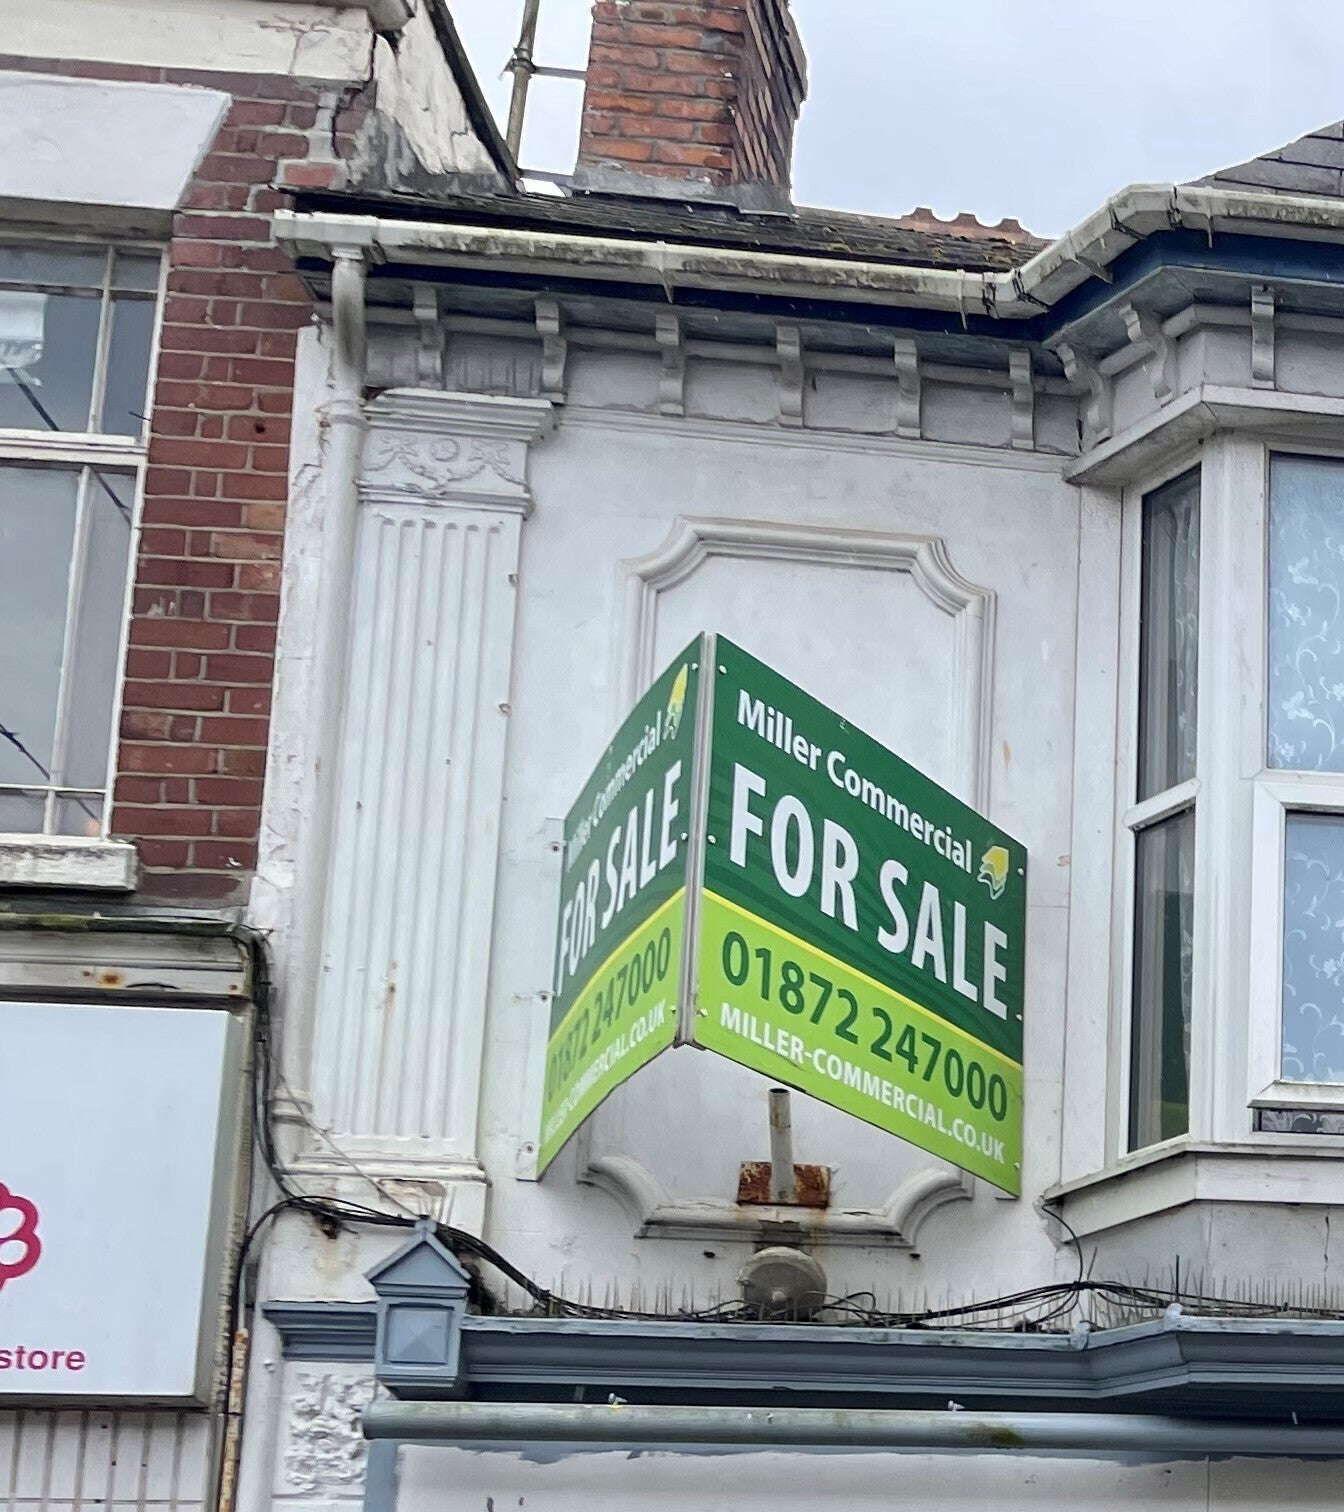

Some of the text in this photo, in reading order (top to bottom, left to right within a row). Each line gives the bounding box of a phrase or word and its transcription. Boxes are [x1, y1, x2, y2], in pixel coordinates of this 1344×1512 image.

[737, 689, 973, 874] Miller Commercial
[555, 857, 601, 997] FOR
[601, 759, 682, 931] SALE
[729, 762, 860, 932] FOR
[878, 860, 1009, 1021] SALE
[591, 926, 672, 1044] 247000
[721, 931, 1009, 1122] 01872 247000
[720, 1002, 1006, 1165] MILLER-COMMERCIAL.CO.UK
[0, 1345, 86, 1371] store
